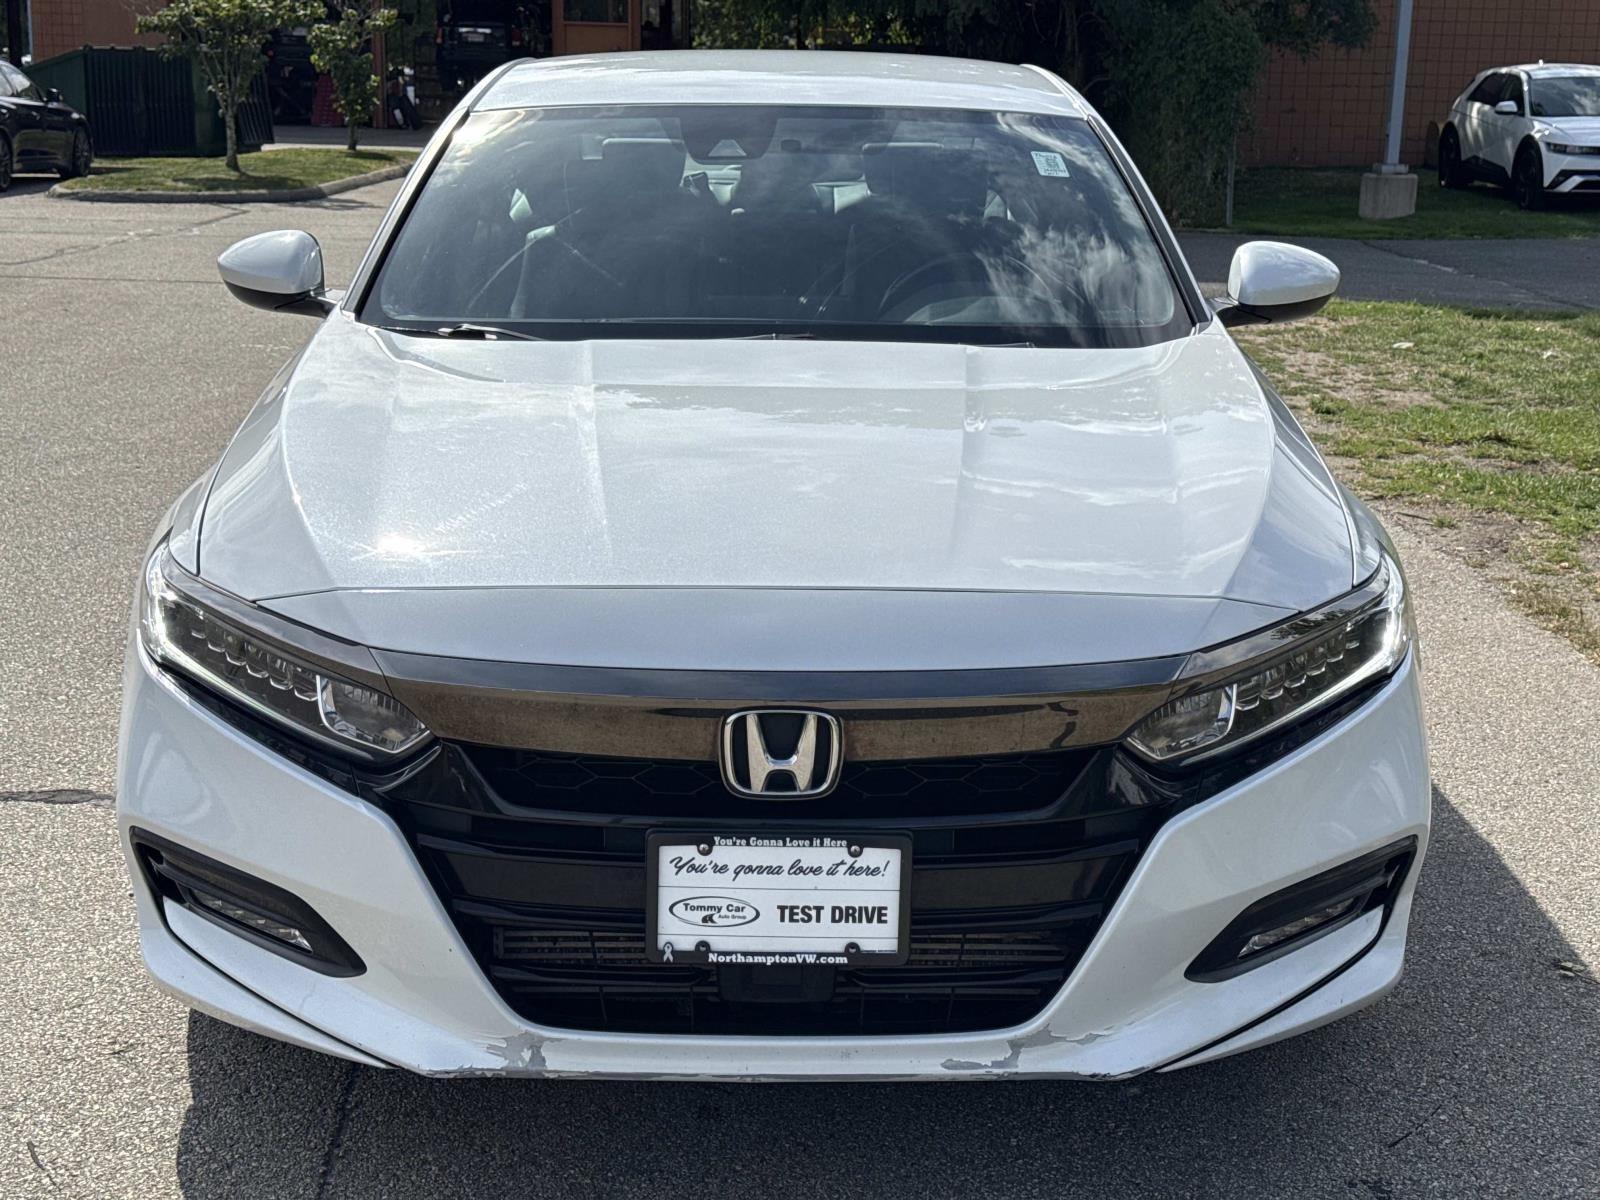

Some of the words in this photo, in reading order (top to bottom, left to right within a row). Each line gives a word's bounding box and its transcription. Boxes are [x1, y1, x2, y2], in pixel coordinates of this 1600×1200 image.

[713, 836, 747, 847] You're
[749, 837, 784, 847] Gonna
[785, 837, 810, 847] Love
[812, 837, 821, 847] it
[823, 838, 848, 847] Here
[669, 856, 730, 876] You're
[733, 864, 784, 881] gonna
[787, 859, 824, 876] love
[825, 859, 847, 876] it
[842, 860, 890, 877] here!
[683, 903, 723, 914] Tommy
[726, 904, 747, 913] Car
[776, 905, 824, 924] TEST
[830, 906, 888, 924] DRIVE
[708, 953, 848, 966] NorthamptonVW.com
